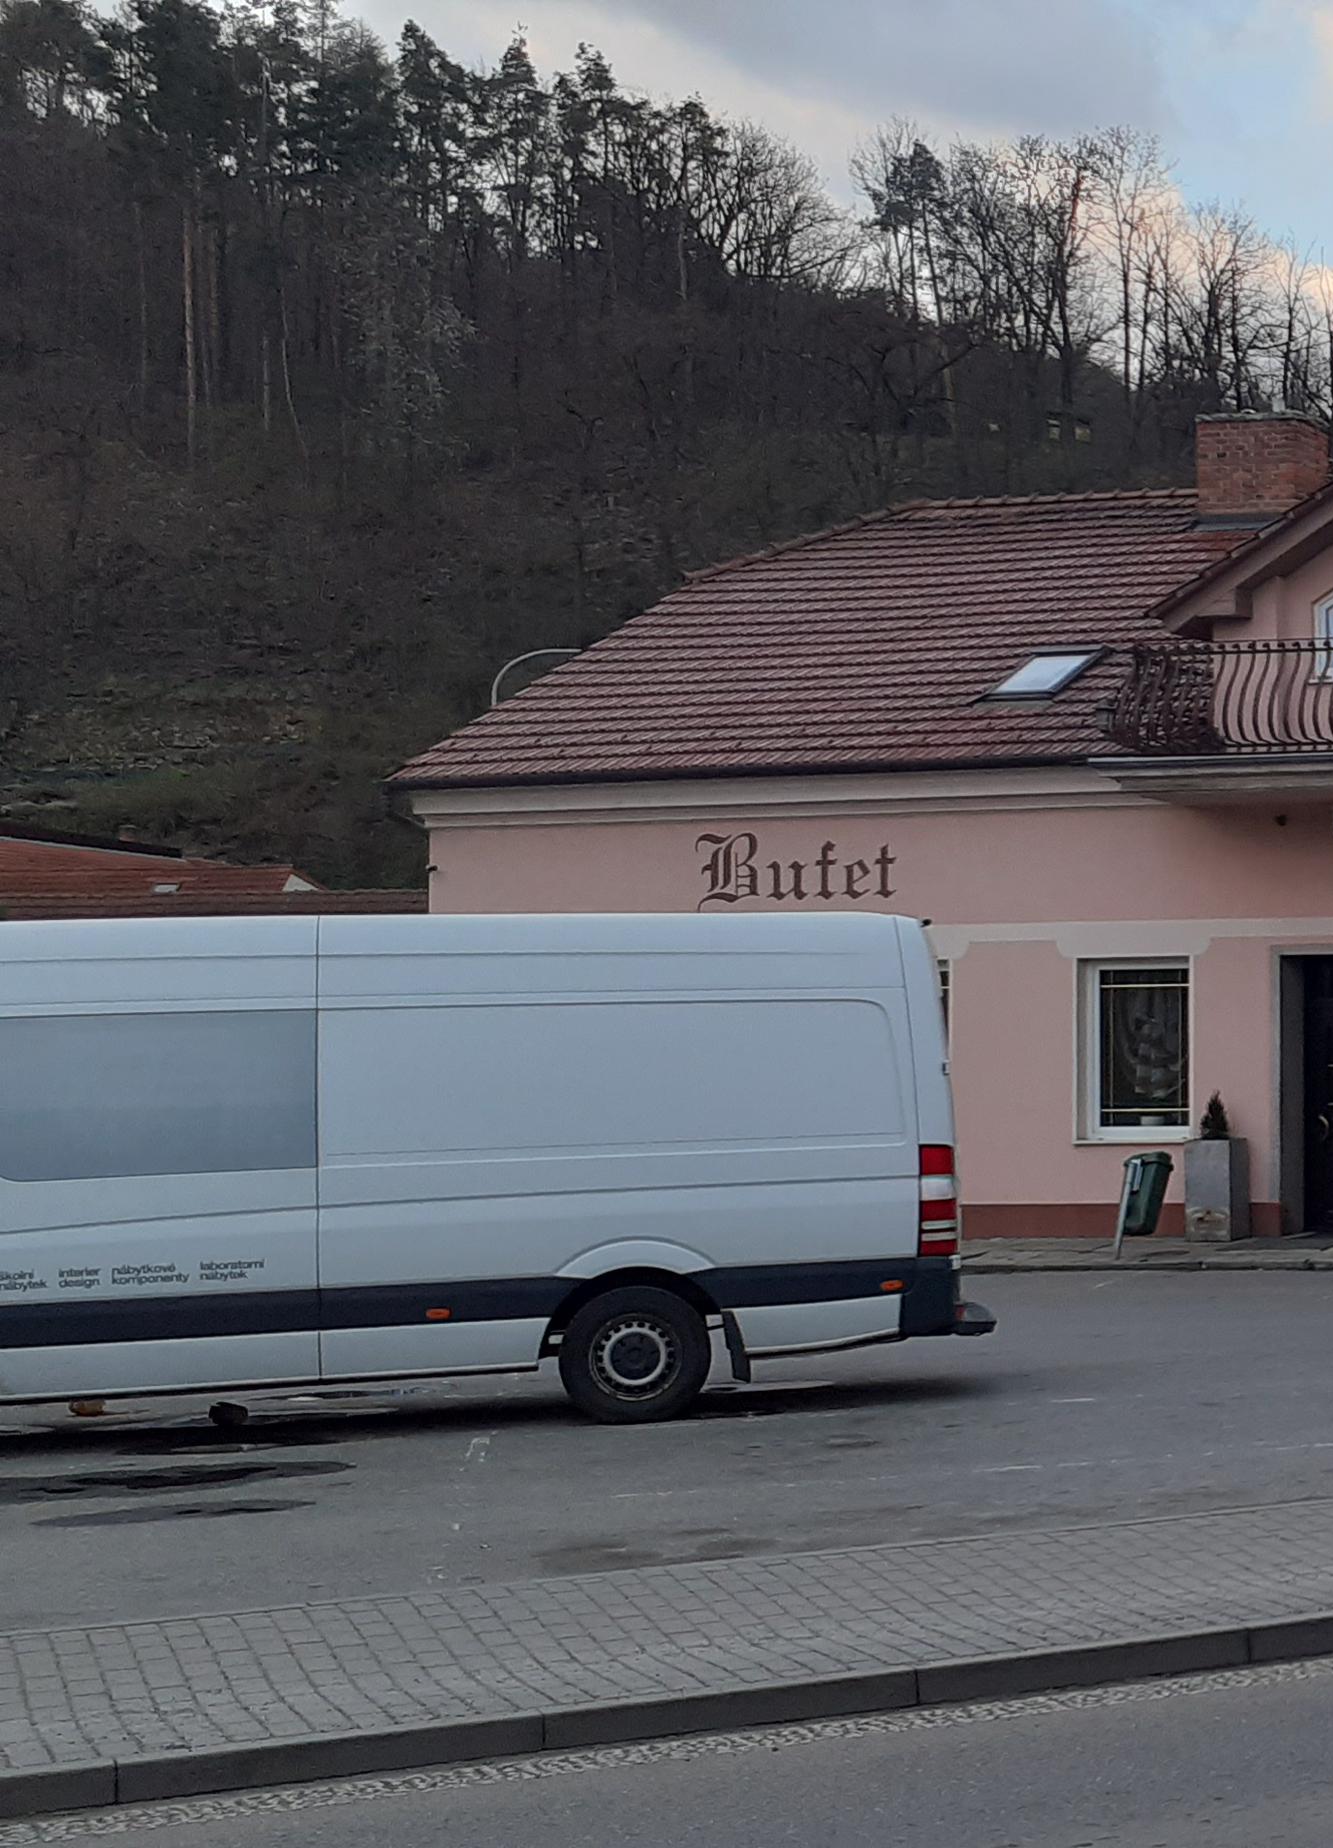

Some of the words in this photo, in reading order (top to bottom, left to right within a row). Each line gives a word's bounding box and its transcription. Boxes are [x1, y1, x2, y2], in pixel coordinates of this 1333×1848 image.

[695, 832, 898, 912] Bufet
[58, 1276, 100, 1288] design
[111, 1272, 190, 1285] komponenty
